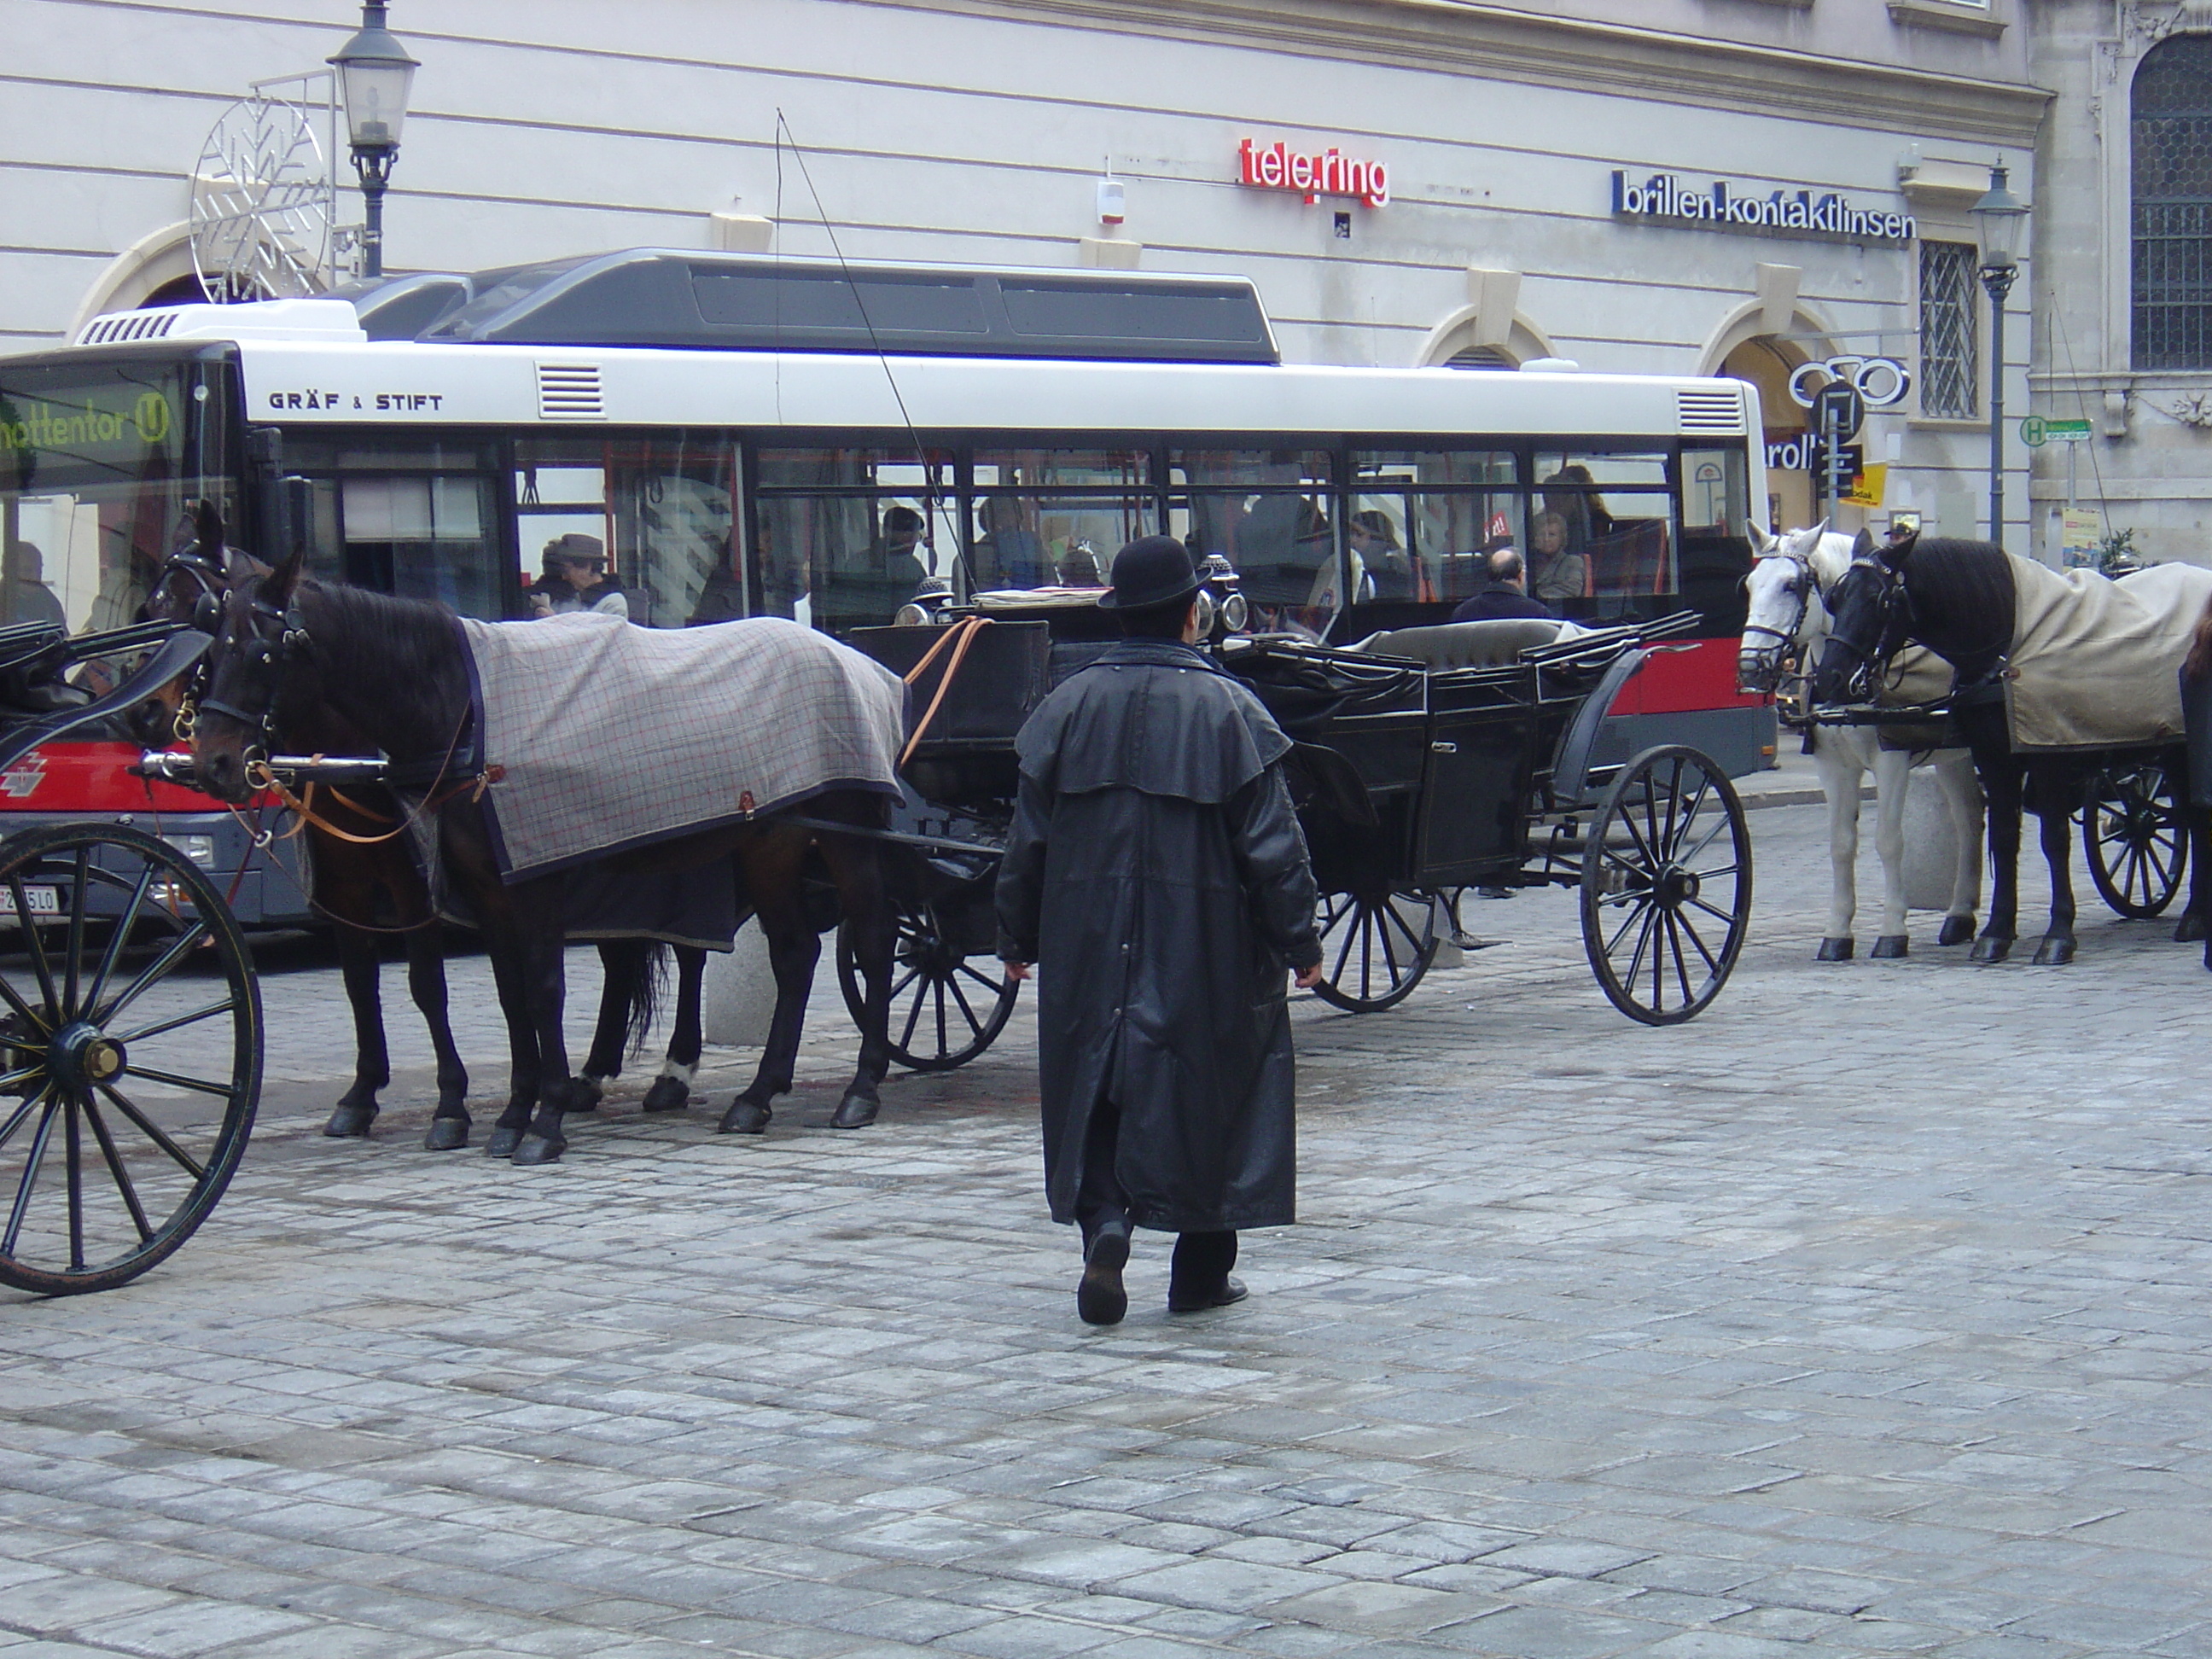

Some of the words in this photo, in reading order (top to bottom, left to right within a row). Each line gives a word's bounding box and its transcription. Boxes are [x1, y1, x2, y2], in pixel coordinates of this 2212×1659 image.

[1238, 137, 1390, 208] tele.ring
[1612, 170, 1918, 240] brillen-kontaktlinsen
[269, 389, 340, 410] GRÄF
[352, 395, 363, 410] &
[375, 394, 443, 410] STIFT
[2027, 422, 2042, 441] H
[1852, 489, 1873, 500] odak
